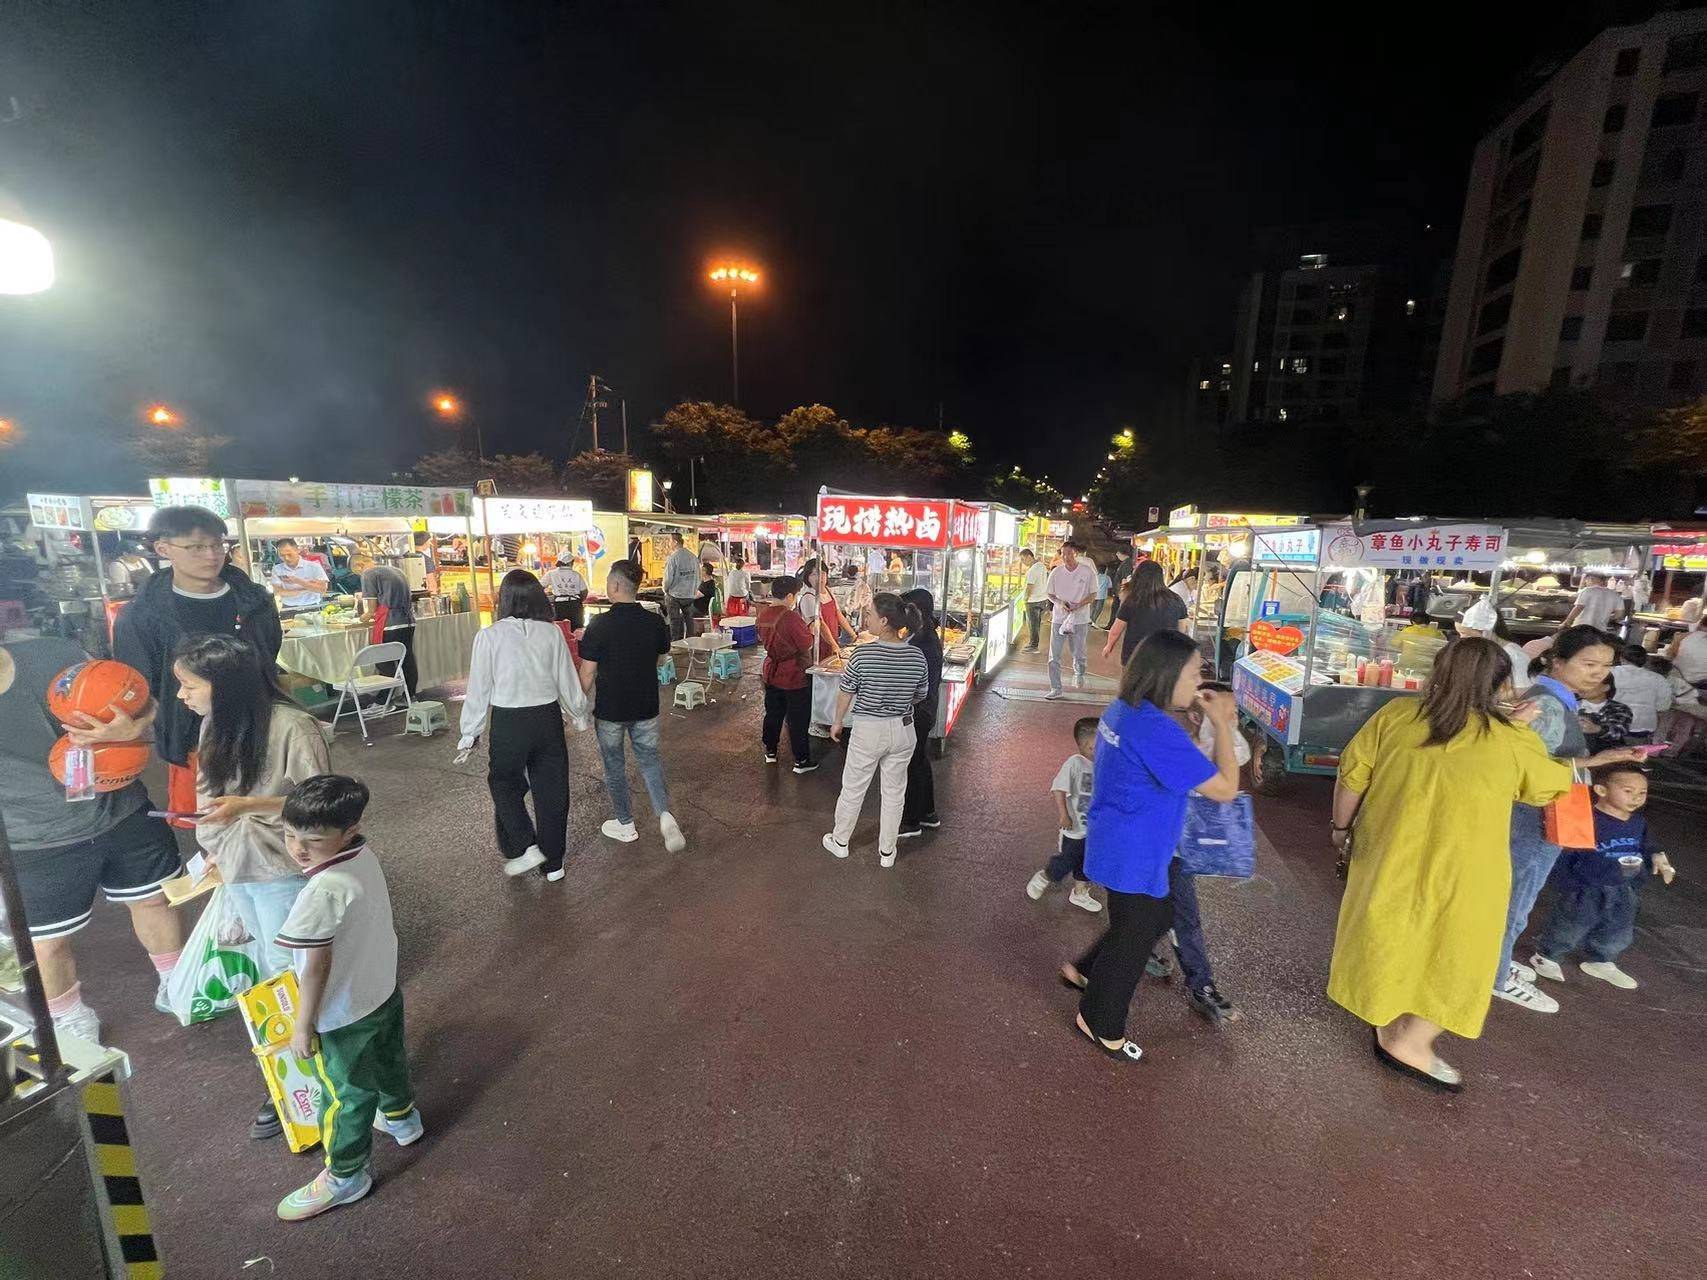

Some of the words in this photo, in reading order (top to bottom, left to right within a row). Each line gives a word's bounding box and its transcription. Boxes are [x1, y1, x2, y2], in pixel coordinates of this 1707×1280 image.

[304, 484, 424, 510] 手打柠檬茶
[821, 505, 941, 542] 现捞热卤
[1371, 533, 1502, 552] 章鱼小丸子寿司
[1402, 555, 1464, 566] 现做现卖
